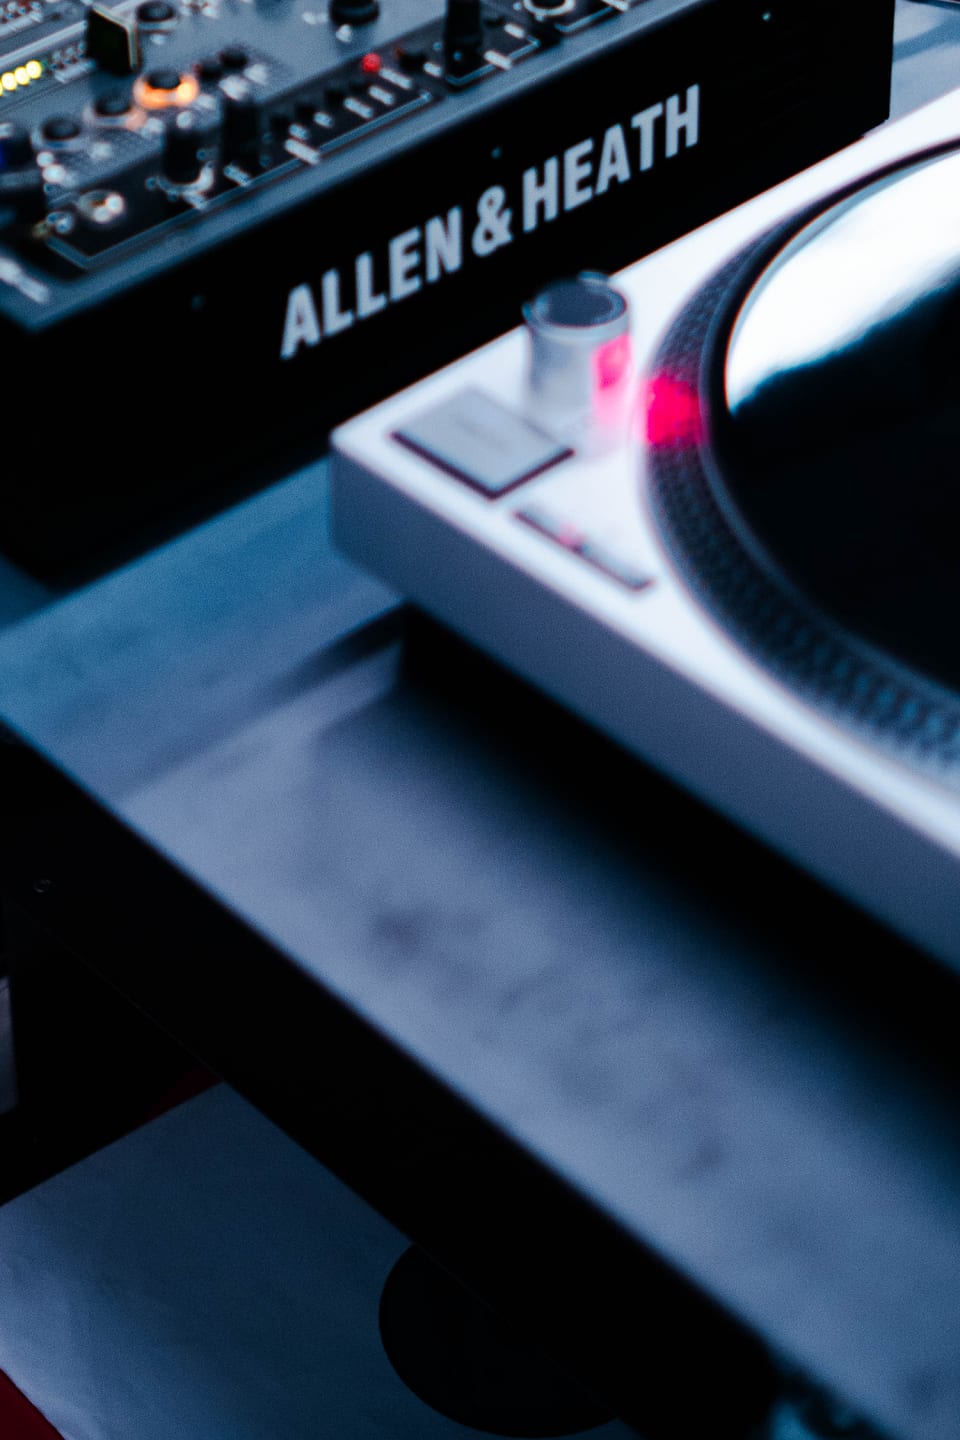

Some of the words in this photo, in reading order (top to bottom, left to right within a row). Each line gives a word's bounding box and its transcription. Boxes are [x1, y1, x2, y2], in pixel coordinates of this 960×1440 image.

[280, 207, 463, 361] ALLEN
[472, 185, 513, 257] &
[521, 83, 701, 234] HEATH
